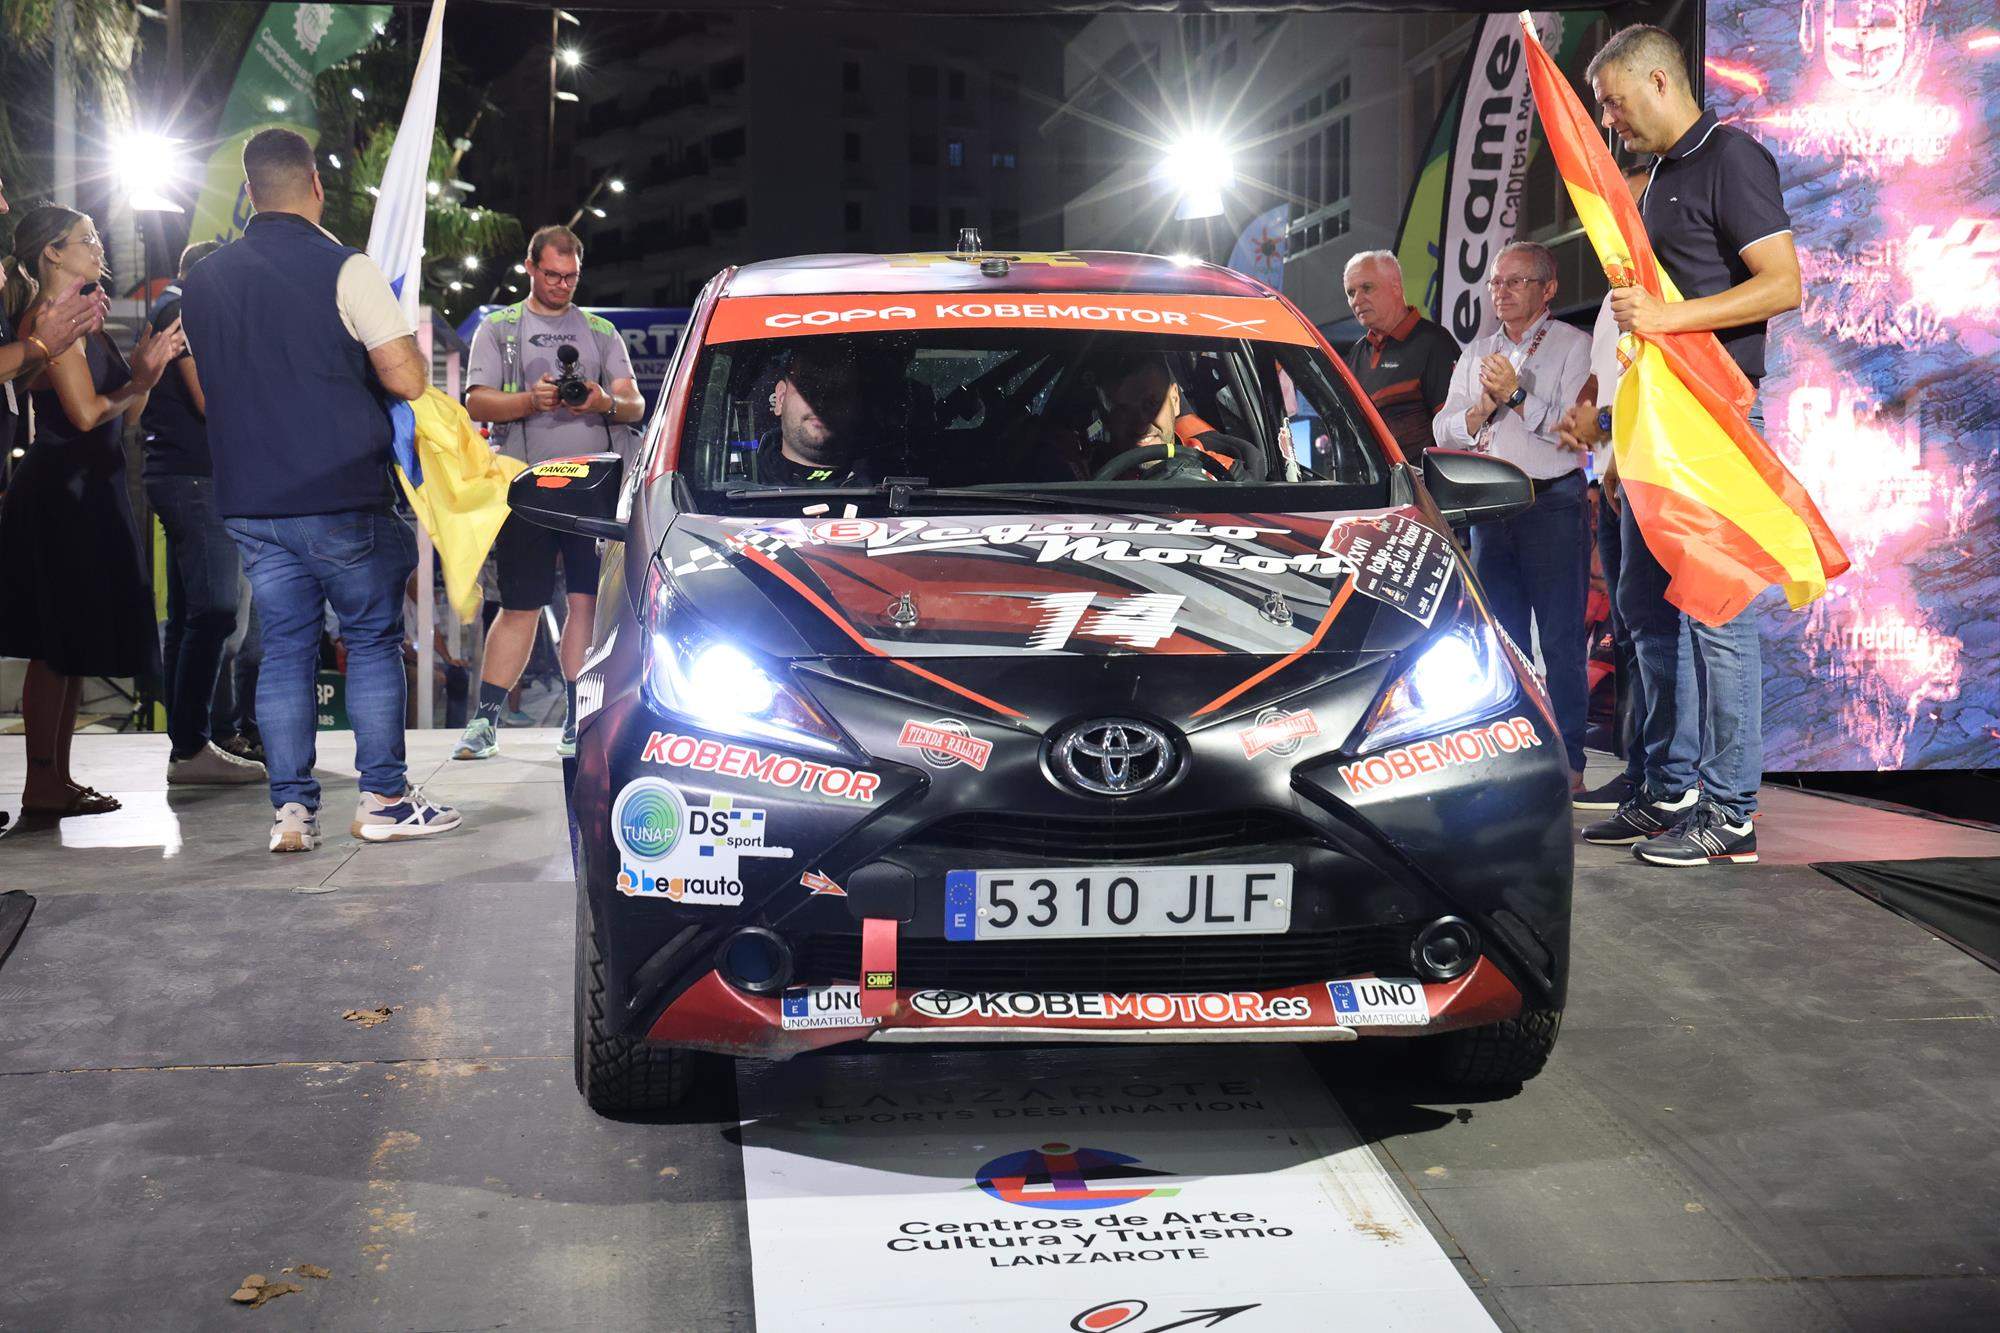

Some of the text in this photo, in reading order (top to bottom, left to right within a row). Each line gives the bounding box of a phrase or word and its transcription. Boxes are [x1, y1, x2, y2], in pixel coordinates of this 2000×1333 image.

[765, 303, 1189, 328] COPA KOBEMOTOR
[539, 466, 580, 474] PANCHI
[866, 514, 1292, 550] Vegauto
[1346, 536, 1372, 567] XXVII
[1366, 548, 1392, 576] Rallye
[1025, 591, 1187, 650] 14
[907, 726, 986, 764] TIENDA RALLYE
[1340, 717, 1541, 794] KOBEMOTOR
[642, 732, 879, 800] KOBEMOTOR
[623, 825, 675, 843] TUNAP
[689, 810, 729, 837] DS
[727, 834, 762, 848] sport
[641, 869, 742, 901] begrauto
[987, 873, 1277, 930] 5310 JLF
[954, 912, 967, 928] E
[867, 975, 893, 986] OMP
[791, 1005, 799, 1014] E
[978, 991, 1310, 1021] KOBEMOTOR.es
[1342, 983, 1417, 1010] E UNO
[1336, 1012, 1429, 1026] UNOMATRICULA
[818, 1099, 1266, 1126] SPORTS DESTINATION
[899, 1211, 1268, 1235] Centros de Arte,
[887, 1224, 1294, 1252] Cultura y Turismo
[990, 1247, 1210, 1268] LANZAROTE
